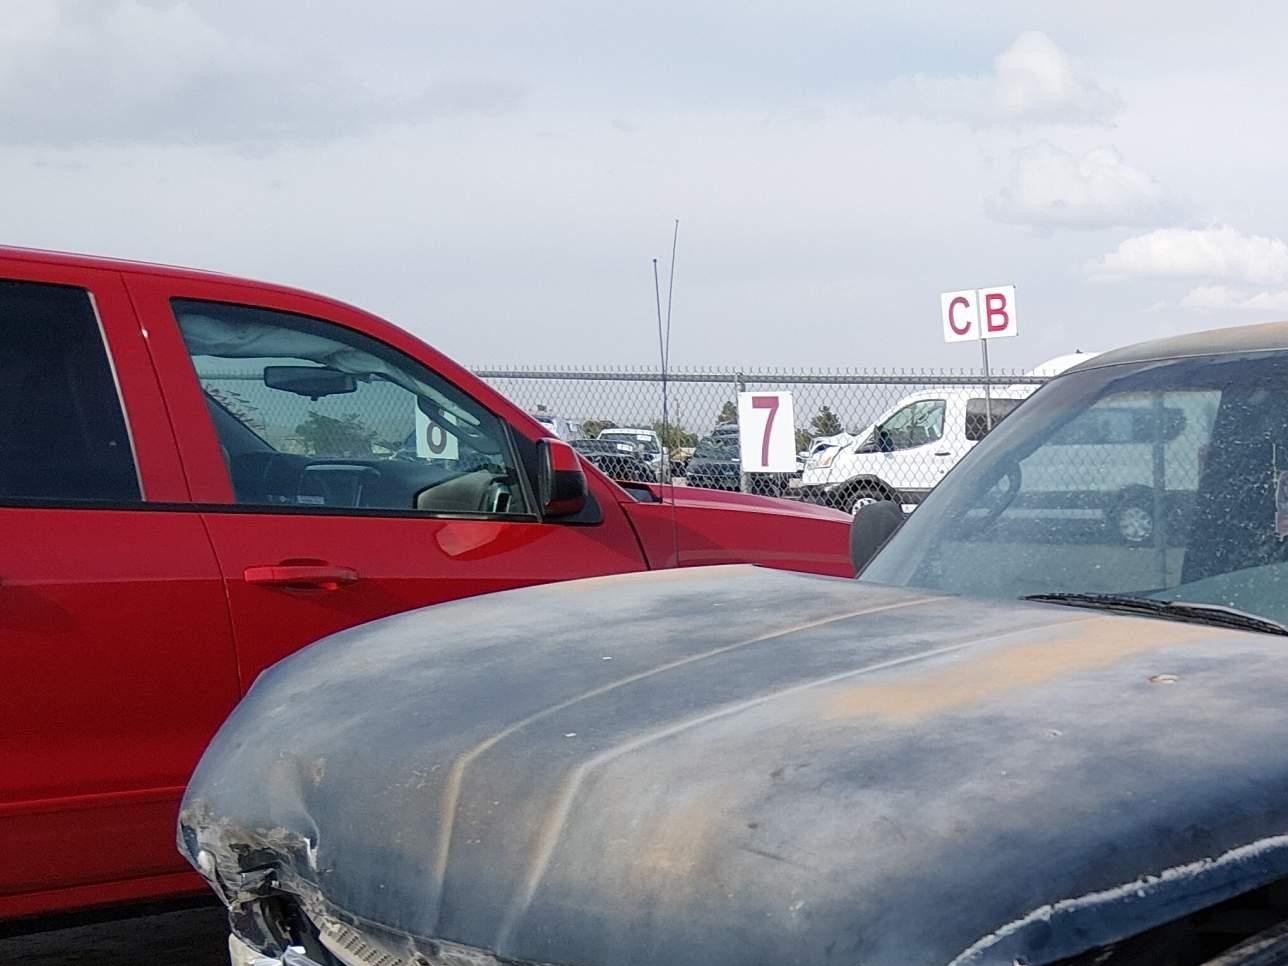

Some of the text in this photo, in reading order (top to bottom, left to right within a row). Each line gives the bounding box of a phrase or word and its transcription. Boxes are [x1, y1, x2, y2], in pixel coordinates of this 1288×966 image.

[948, 293, 1009, 336] C B
[751, 395, 779, 467] 7
